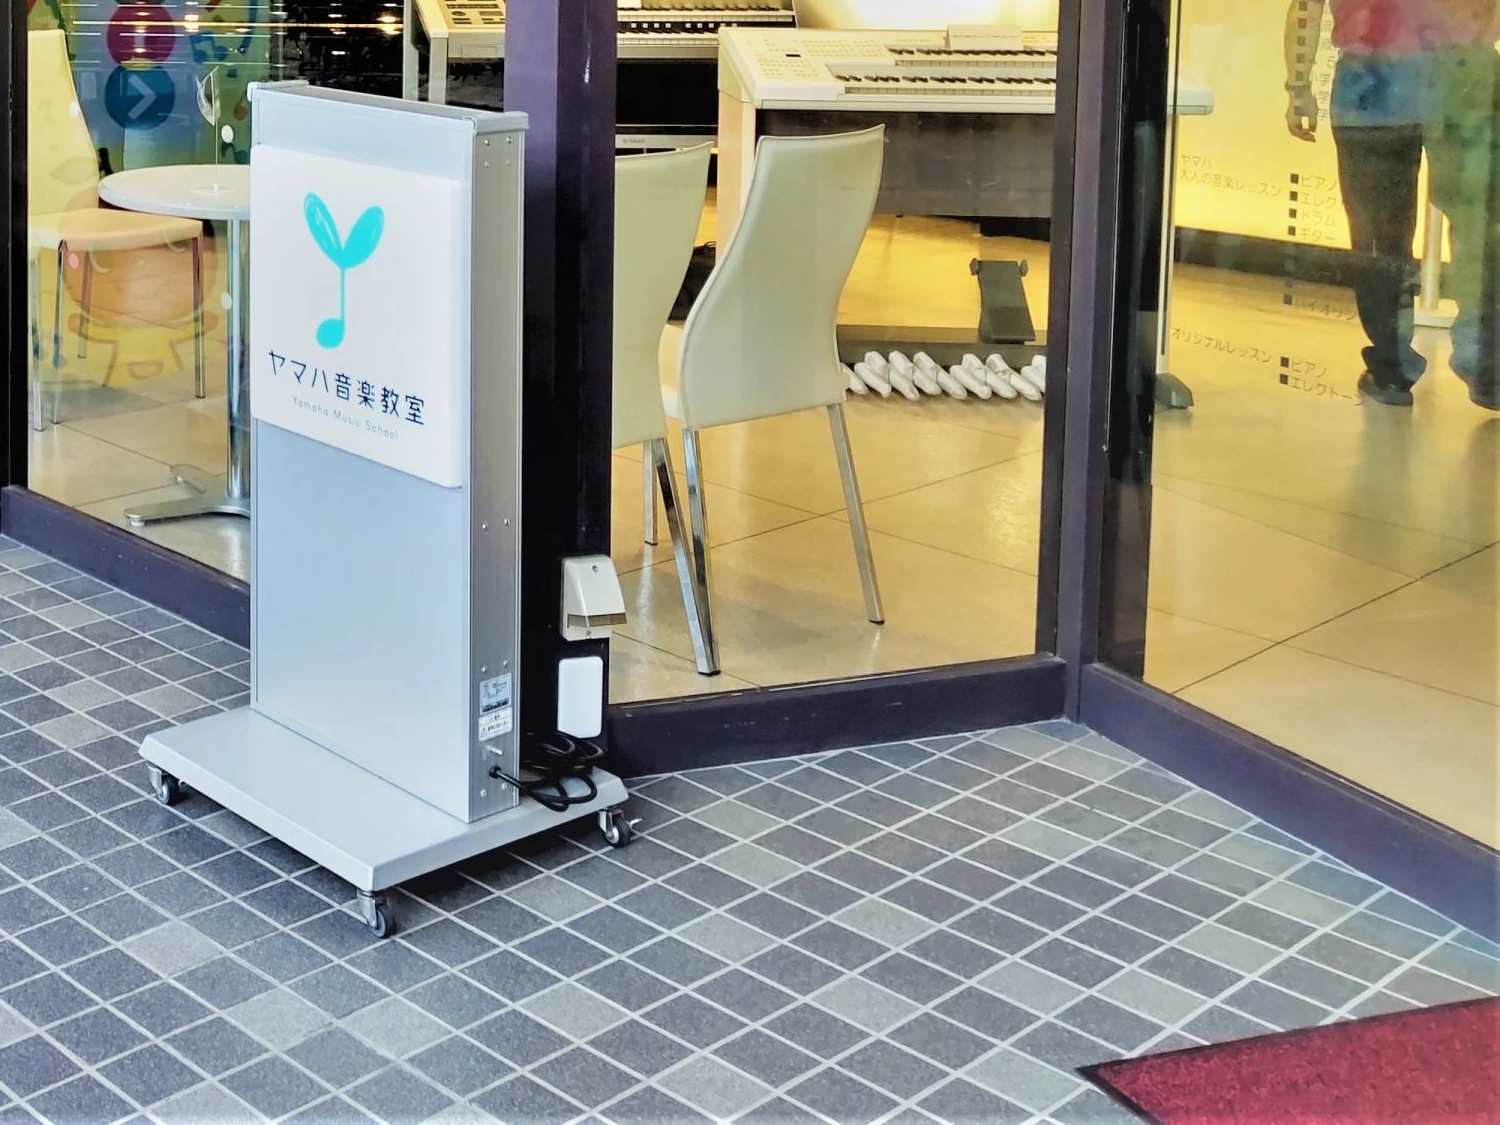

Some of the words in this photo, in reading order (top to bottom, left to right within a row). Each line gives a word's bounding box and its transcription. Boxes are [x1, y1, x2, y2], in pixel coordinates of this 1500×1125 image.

[1180, 155, 1212, 169] ヤマハ
[1179, 169, 1282, 197] 大人の音楽レッスン
[1301, 191, 1343, 210] エレク
[1300, 227, 1336, 242] ギター
[1171, 328, 1273, 363] オリジナルレッスン
[268, 350, 425, 426] ヤマハ音楽教室
[292, 394, 329, 417] Yamaha
[333, 410, 361, 427] Music
[366, 420, 398, 440] School
